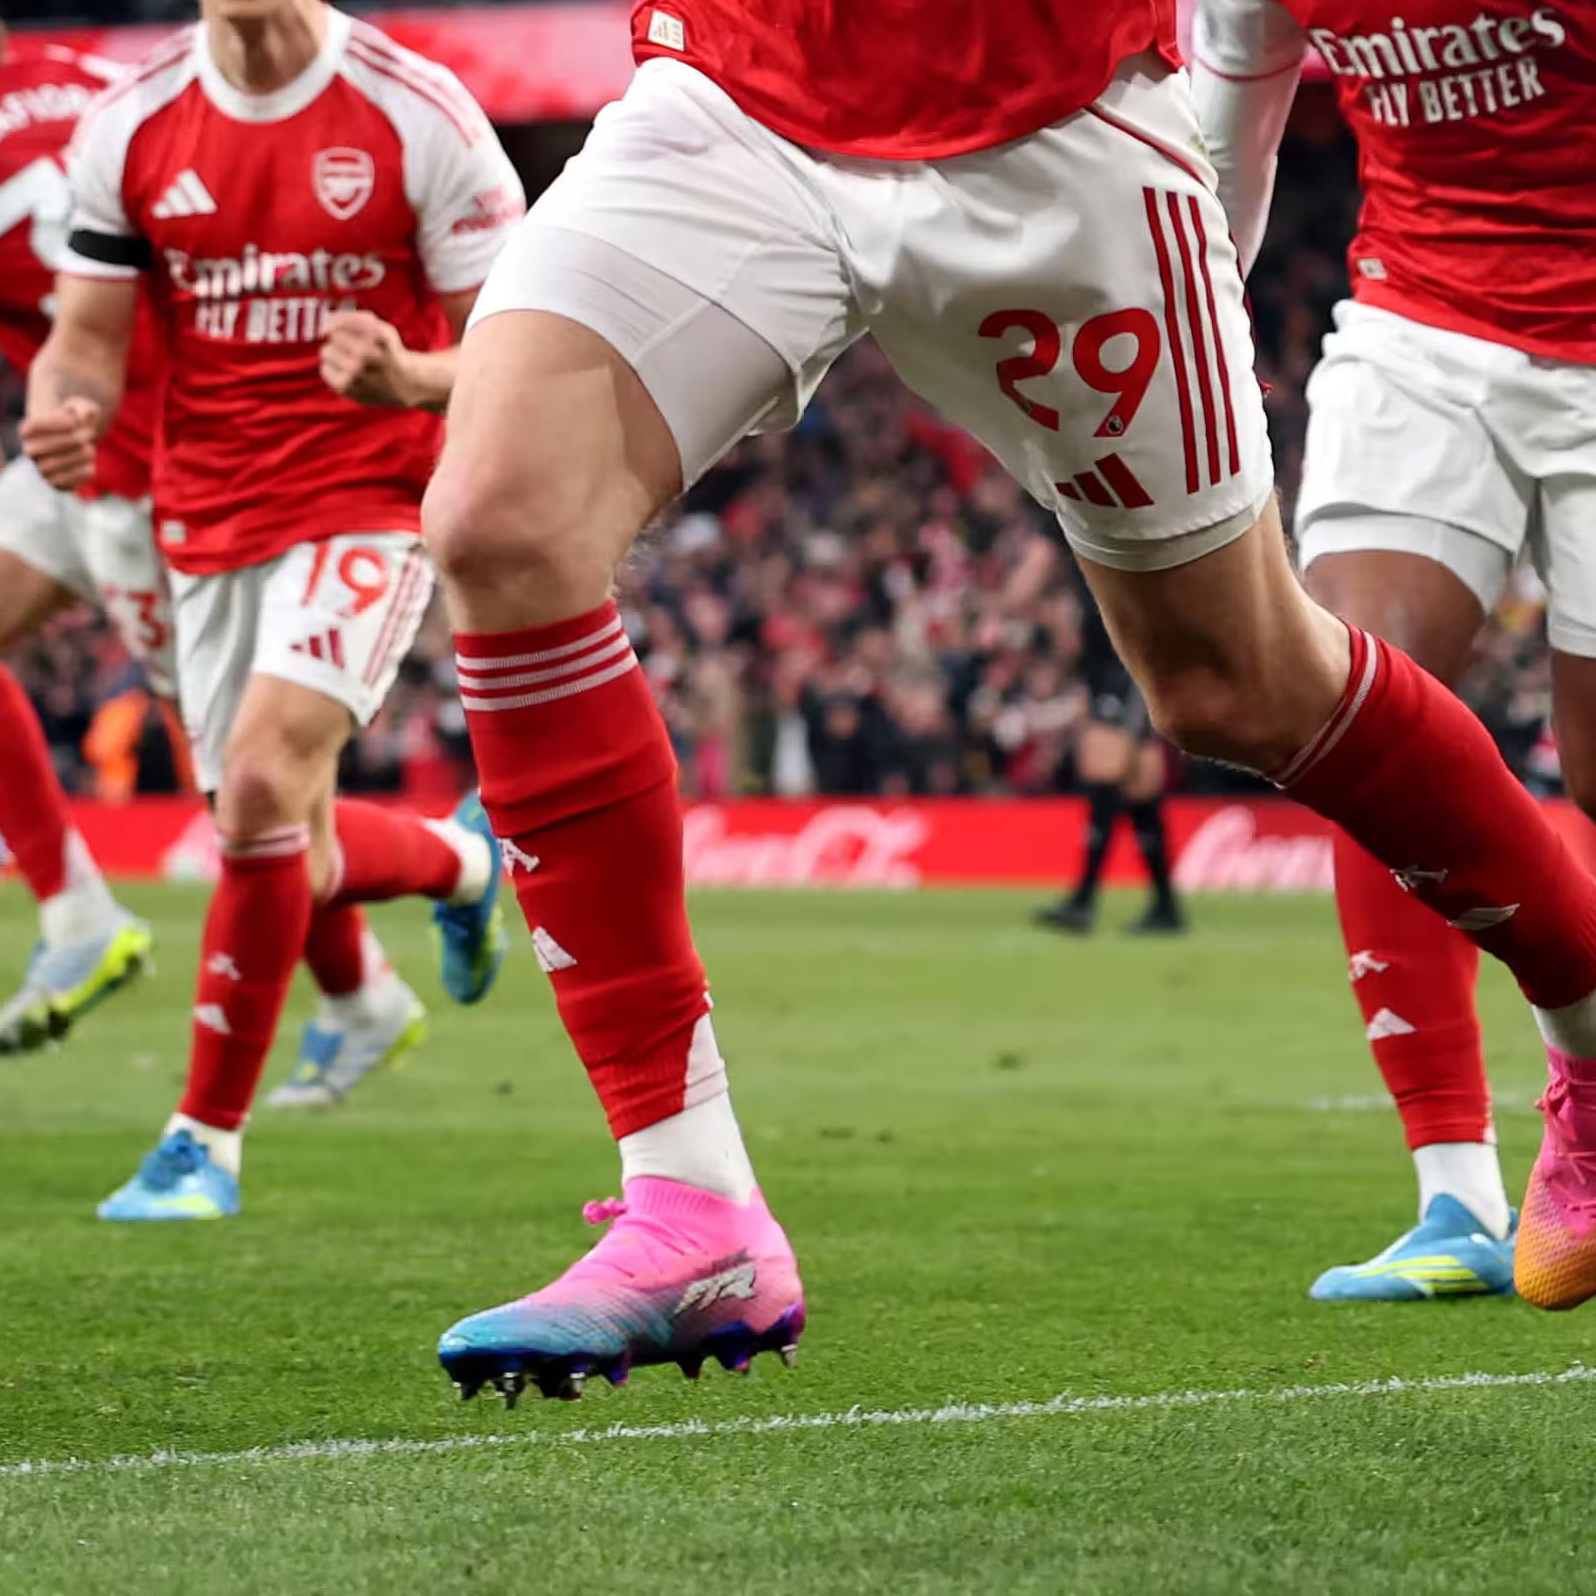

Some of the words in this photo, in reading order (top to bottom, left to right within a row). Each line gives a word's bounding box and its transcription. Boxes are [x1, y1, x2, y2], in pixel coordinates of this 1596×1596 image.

[1308, 7, 1566, 79] Emirates
[1364, 82, 1410, 127] FLY
[1418, 56, 1547, 124] BETTER
[164, 243, 386, 299] Emirates
[978, 307, 1161, 437] 29
[300, 540, 390, 619] 19
